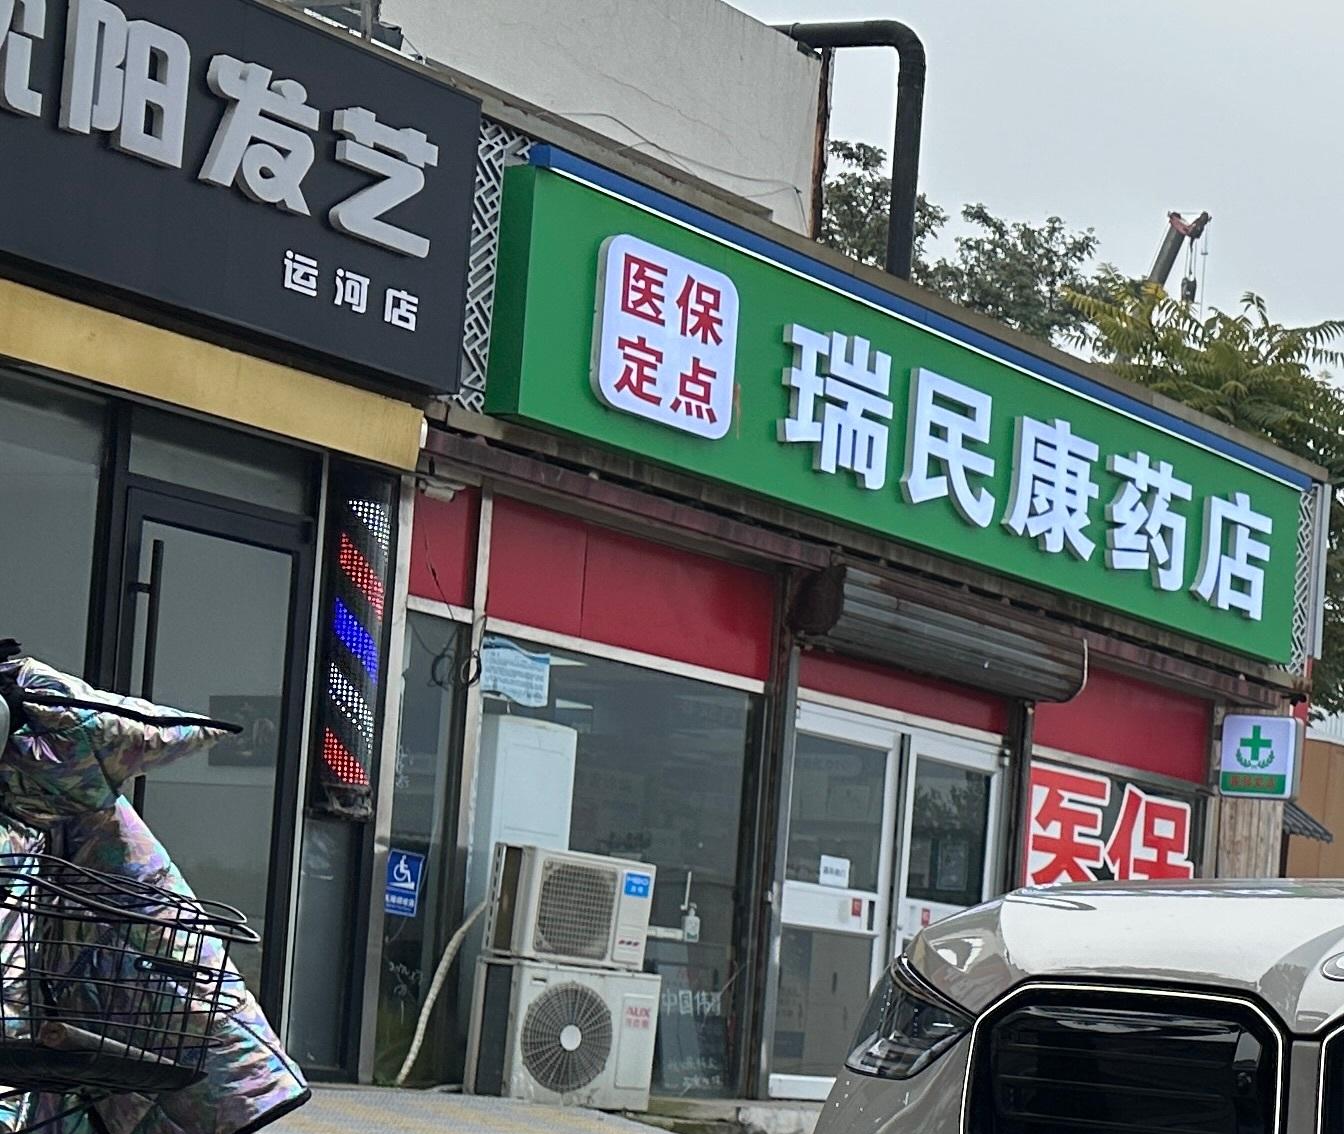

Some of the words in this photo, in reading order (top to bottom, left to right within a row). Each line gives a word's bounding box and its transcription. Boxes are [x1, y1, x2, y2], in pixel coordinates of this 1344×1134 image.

[283, 249, 419, 332] 运河店
[620, 252, 724, 347] 医保
[614, 335, 718, 425] 定点
[776, 324, 1273, 621] 瑞民康药店
[1027, 763, 1193, 887] 医保
